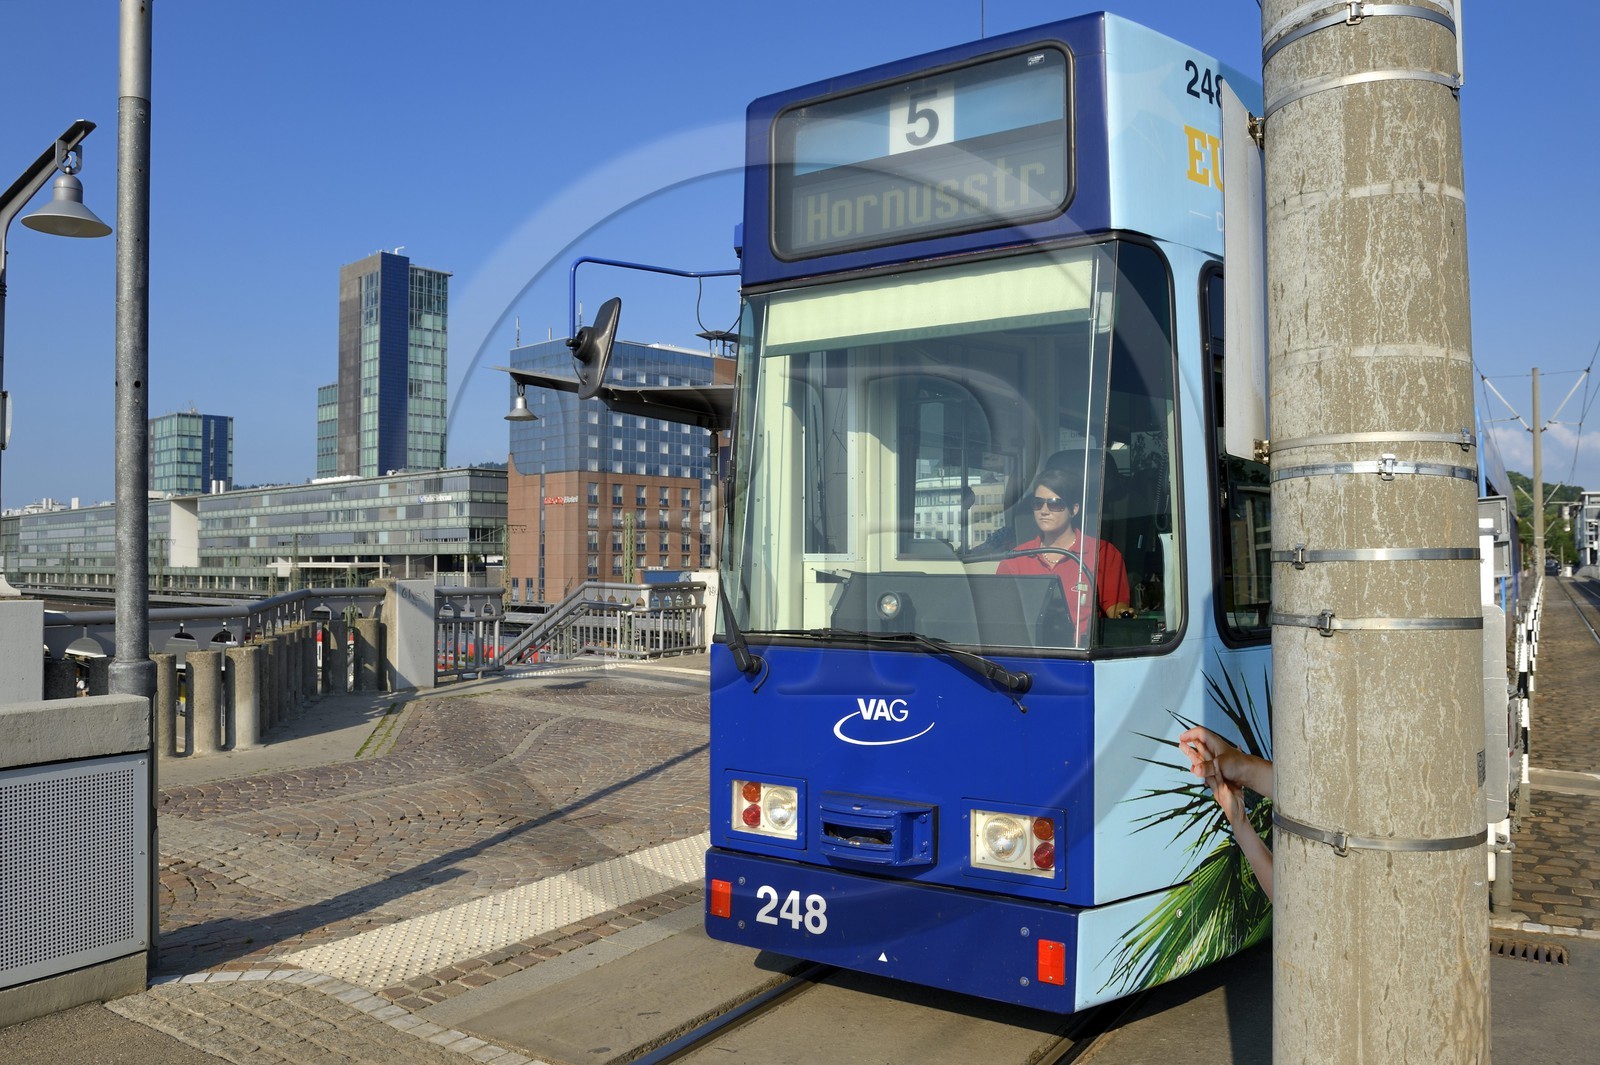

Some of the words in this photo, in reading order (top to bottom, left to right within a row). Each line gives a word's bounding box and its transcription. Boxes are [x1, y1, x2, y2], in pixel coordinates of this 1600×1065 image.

[905, 89, 940, 147] 5
[806, 158, 1060, 243] Hornusstr.
[856, 698, 909, 723] VAG
[755, 885, 829, 935] 248
